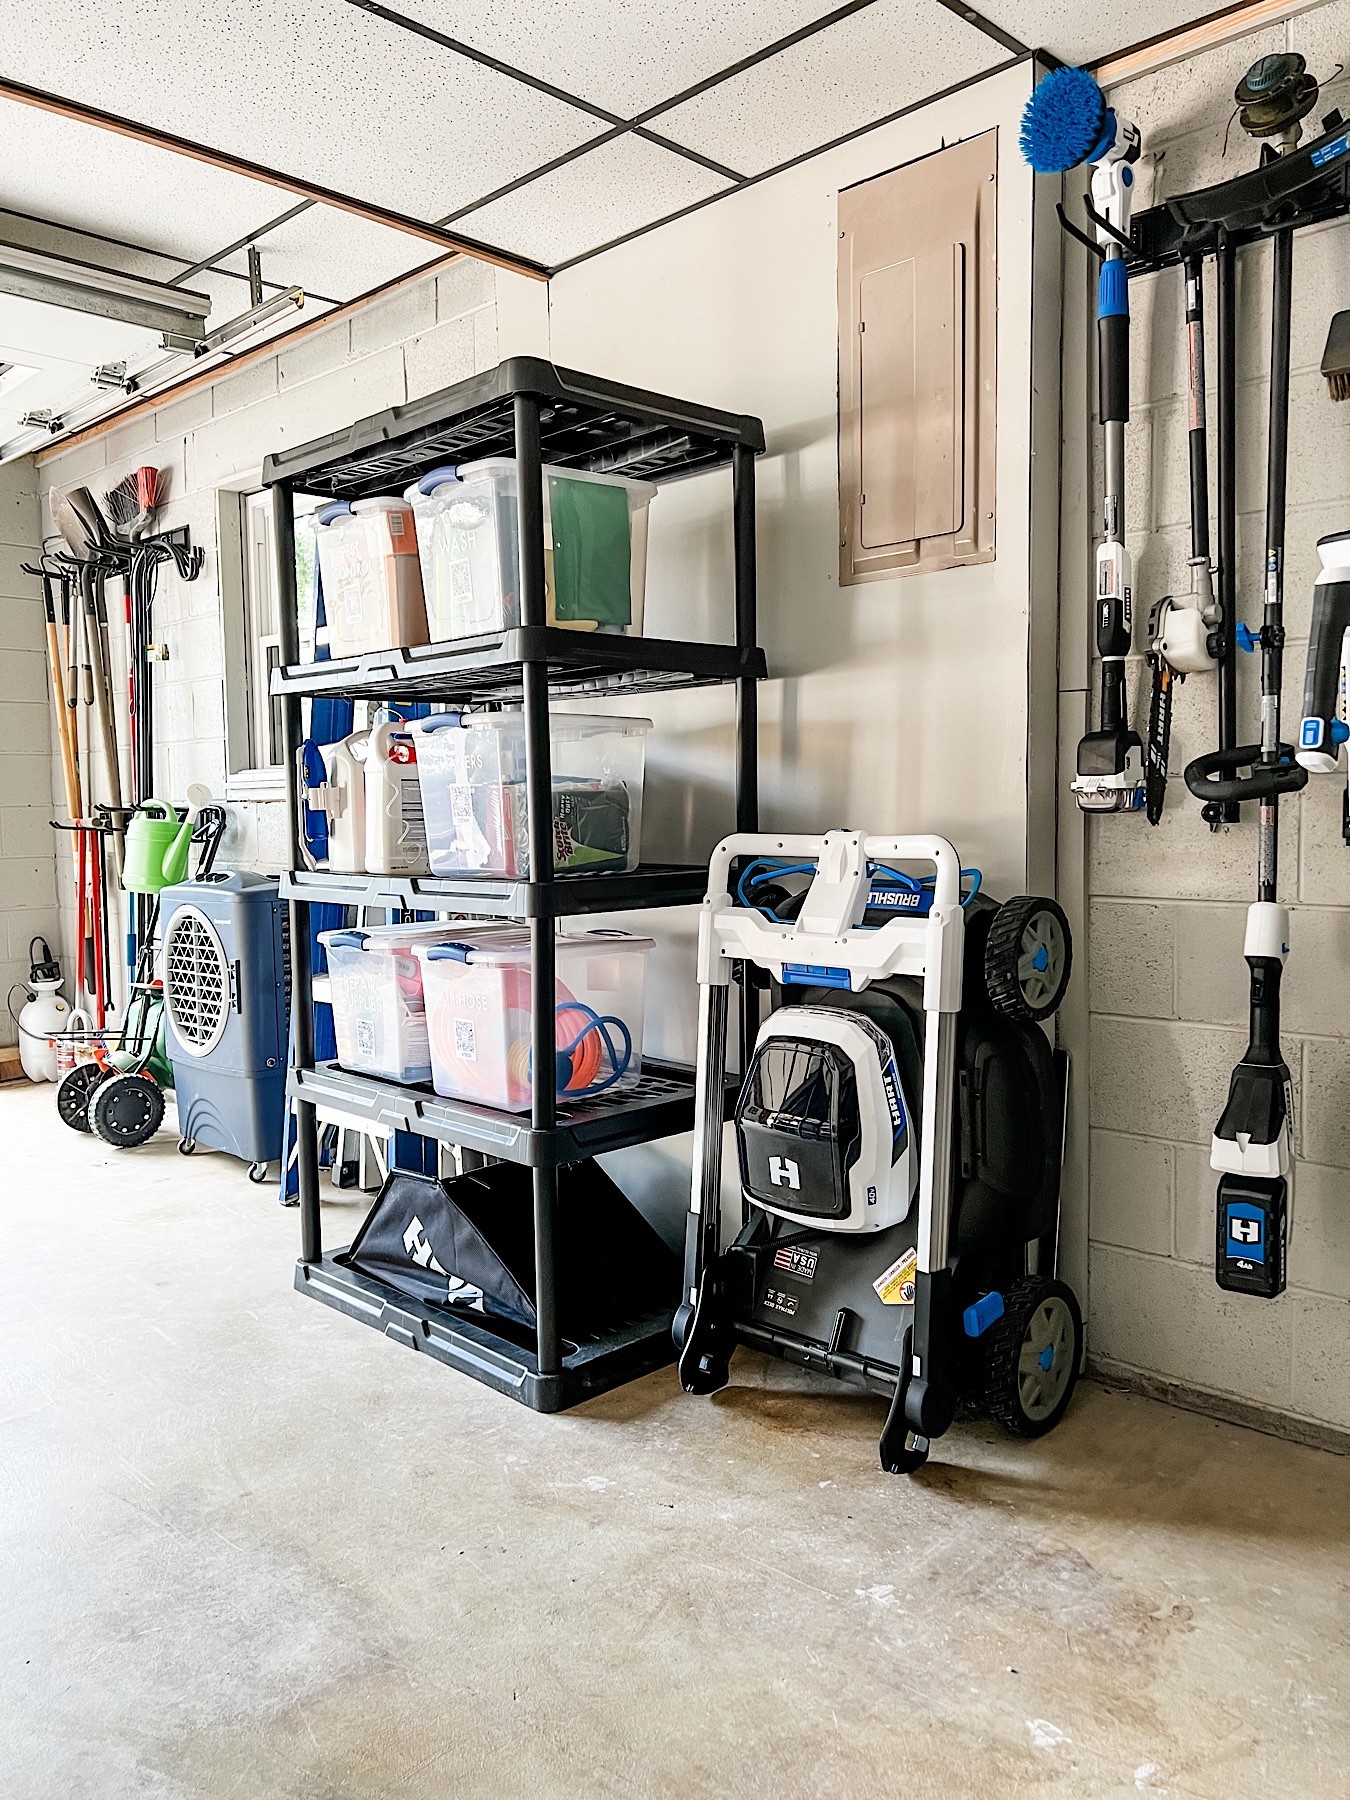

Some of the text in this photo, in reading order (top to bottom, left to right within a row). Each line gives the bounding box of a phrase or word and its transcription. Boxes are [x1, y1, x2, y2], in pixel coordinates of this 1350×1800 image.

[438, 529, 476, 556] WASH
[1157, 692, 1167, 747] HART
[343, 974, 377, 994] REPAIR
[342, 991, 383, 1013] SUPPLIES
[459, 993, 488, 1011] HOSE
[883, 1075, 902, 1126] HART
[769, 1156, 801, 1190] H
[1231, 1218, 1259, 1243] H
[793, 1253, 815, 1269] USA
[796, 1264, 813, 1276] MADE
